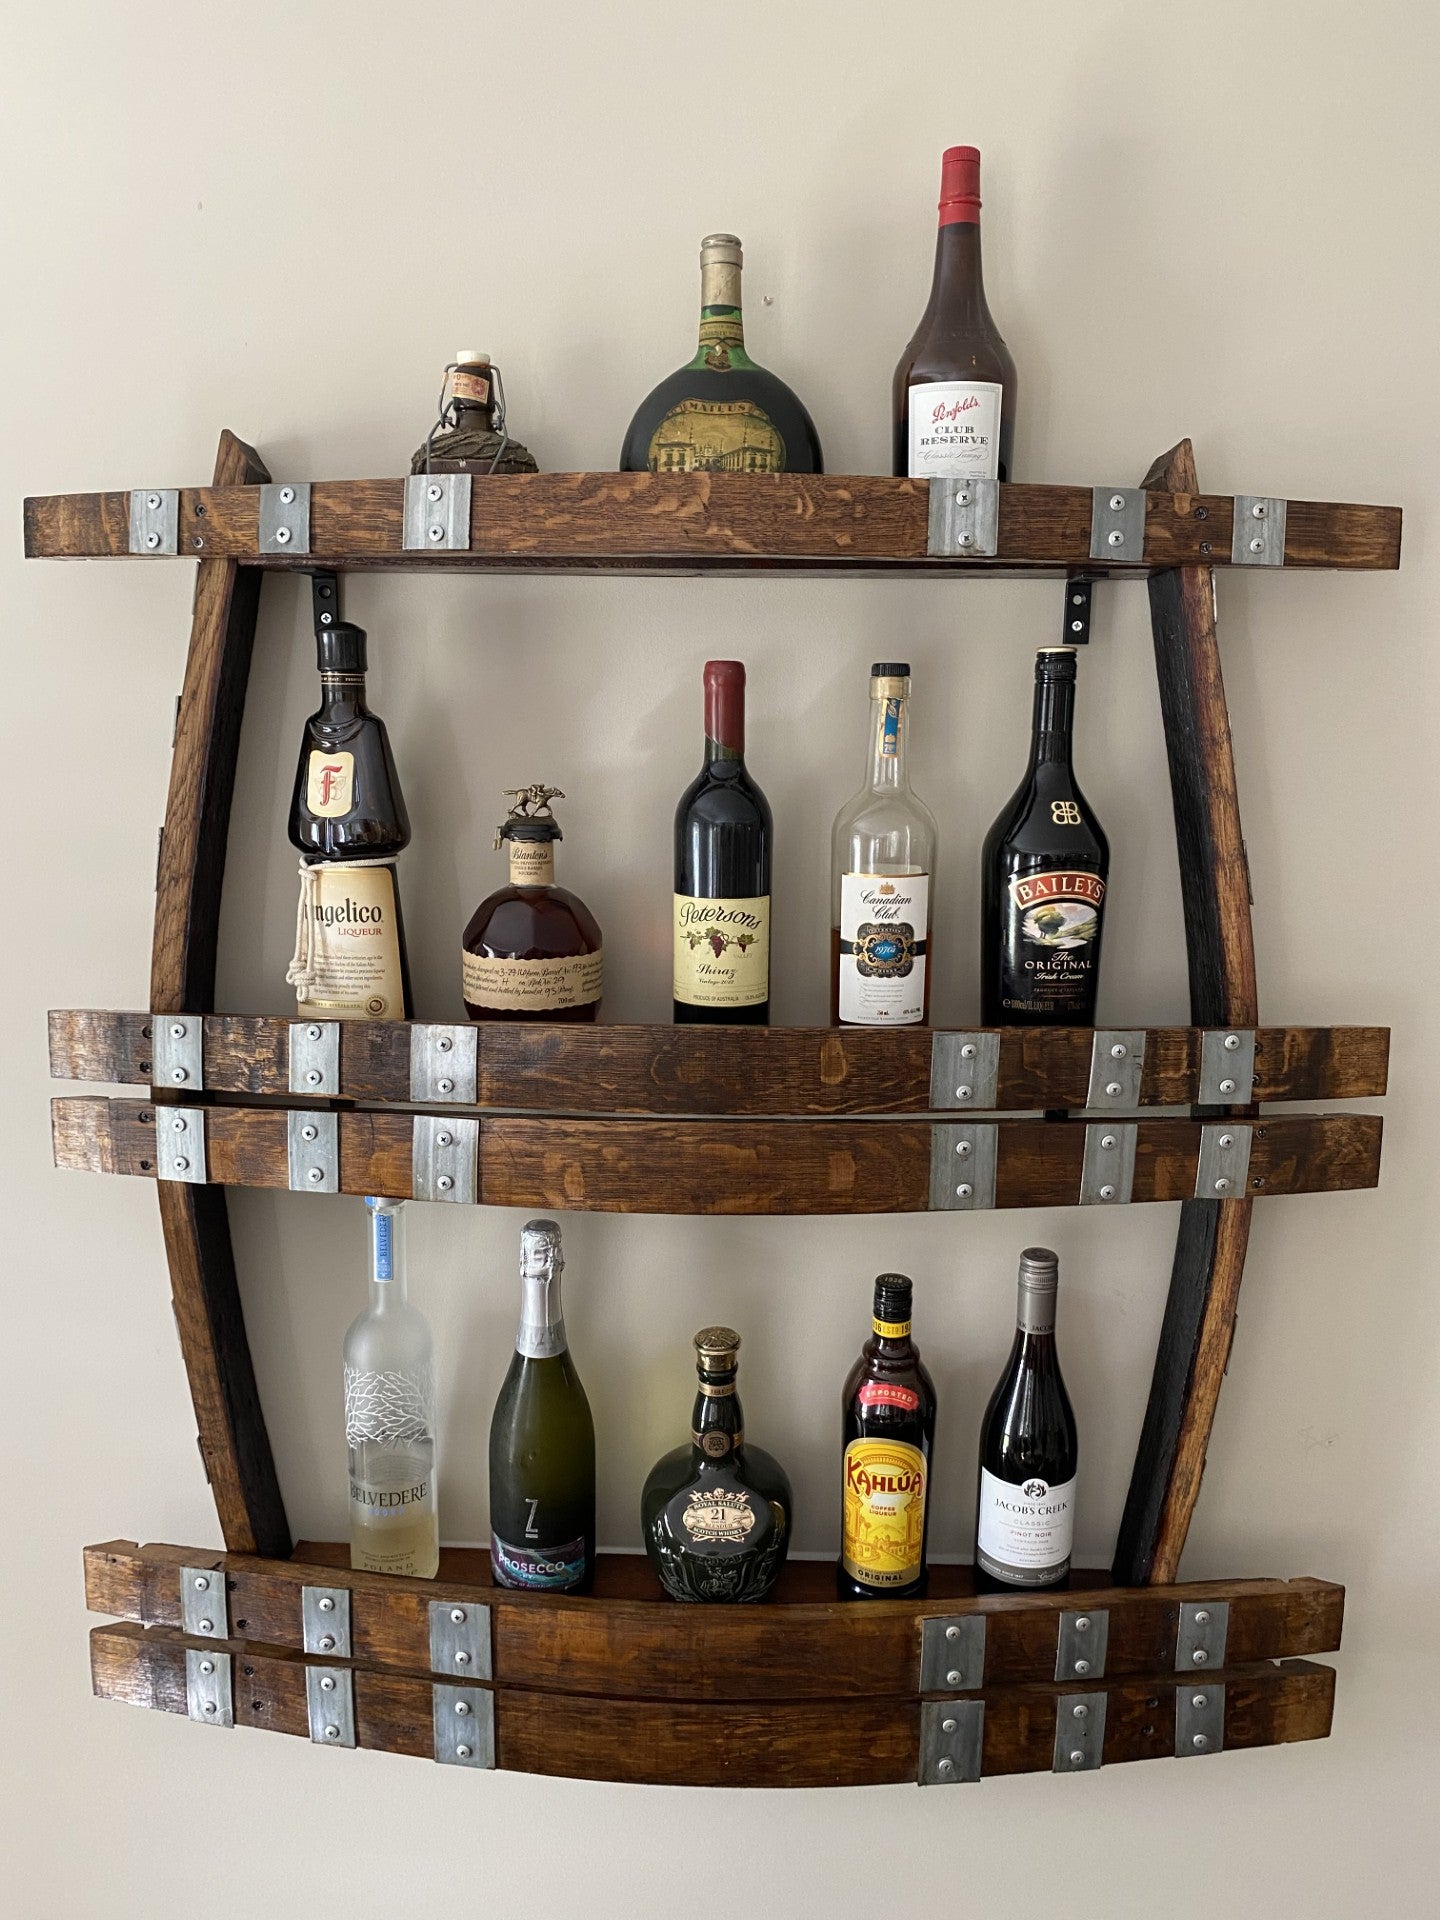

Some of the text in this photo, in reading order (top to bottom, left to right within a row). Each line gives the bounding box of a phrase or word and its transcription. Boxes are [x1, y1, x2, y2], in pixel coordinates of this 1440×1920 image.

[690, 402, 747, 413] MATEUS
[932, 396, 980, 424] Penfolds
[935, 426, 975, 434] CLUB
[920, 435, 989, 446] RESERVE
[513, 847, 548, 860] Blanton's
[1018, 877, 1104, 901] BAILEYS
[860, 890, 912, 905] Canadian
[679, 902, 762, 930] Petersons
[872, 905, 900, 920] Club
[338, 927, 382, 937] LIQUEUR
[1051, 951, 1075, 961] The
[696, 963, 737, 979] Shiraz
[1024, 960, 1092, 970] ORIGINAL
[1034, 972, 1084, 980] Irish Cream
[866, 1389, 913, 1402] IMPORTED
[847, 1456, 924, 1497] KAHLÚA
[693, 1501, 746, 1510] ROYAL SALUTE
[1038, 1502, 1068, 1515] CREEK
[711, 1508, 725, 1520] 21
[693, 1526, 742, 1536] SCOTCH WHISKY
[1010, 1530, 1031, 1538] PINOT
[498, 1553, 565, 1574] PROSECCO
[858, 1569, 903, 1582] ORIGINAL
